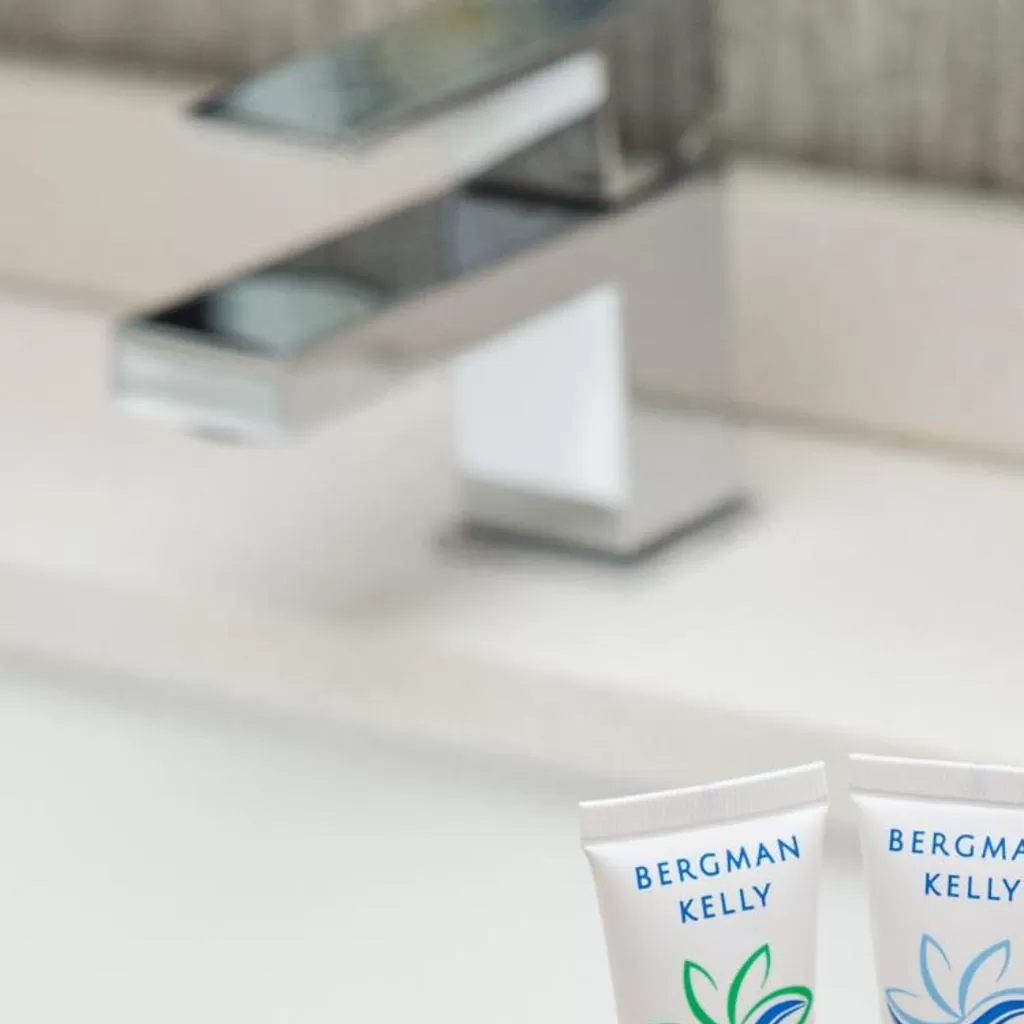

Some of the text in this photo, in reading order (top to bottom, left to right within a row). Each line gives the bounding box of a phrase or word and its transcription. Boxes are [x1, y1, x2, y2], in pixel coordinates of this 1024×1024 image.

[635, 836, 800, 890] BERGMAN
[679, 883, 772, 924] KELLY
[924, 872, 1022, 902] KELLY
